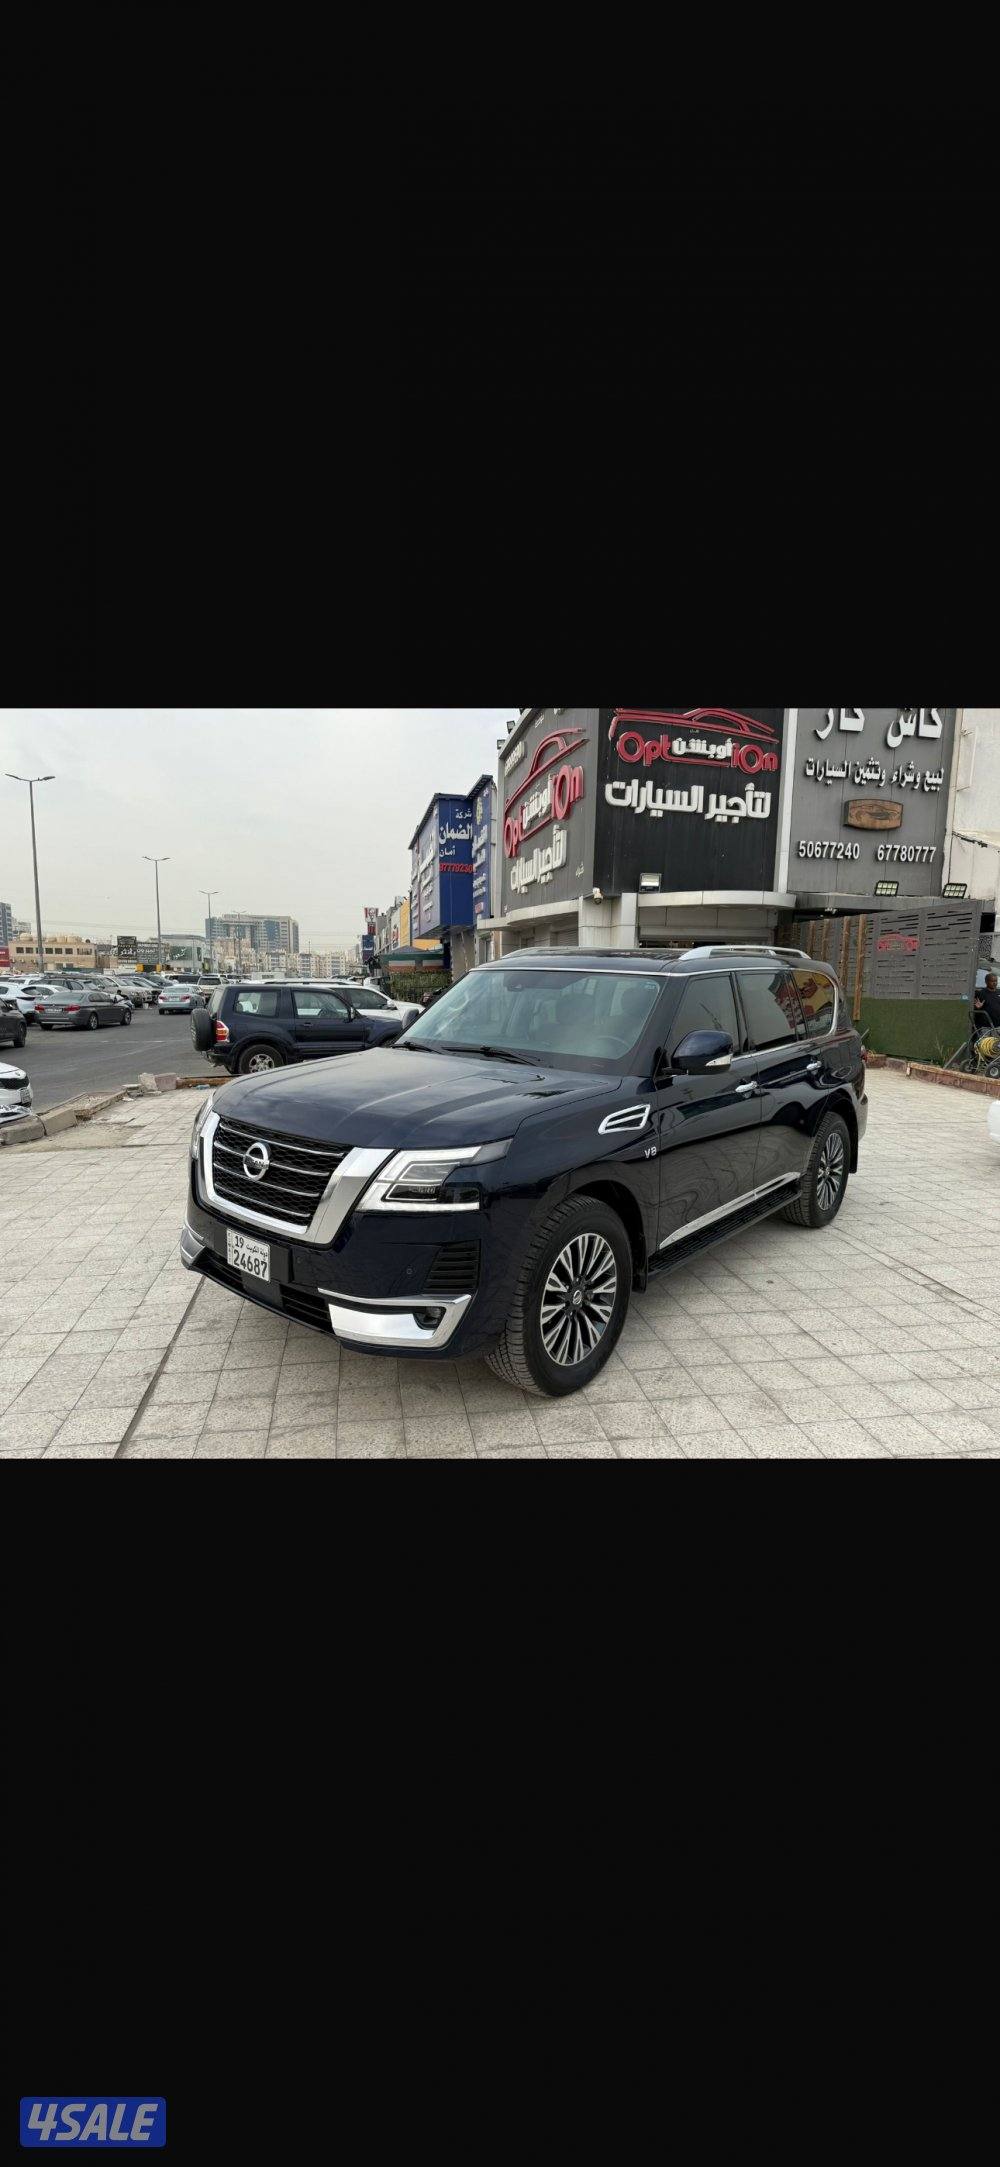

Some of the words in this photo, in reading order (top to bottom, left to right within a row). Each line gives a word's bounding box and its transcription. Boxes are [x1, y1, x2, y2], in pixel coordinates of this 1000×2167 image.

[805, 757, 851, 785] السيارات
[854, 757, 886, 787] وتثمين
[891, 761, 921, 789] وشراء
[924, 767, 945, 791] لبيع
[605, 778, 705, 818] السيارات
[704, 782, 772, 824] لتأجير
[455, 808, 472, 819] شركة
[439, 822, 473, 844] الضمان
[538, 824, 567, 884] لتأجير
[798, 840, 860, 860] 50677240
[877, 844, 937, 862] 67780777
[510, 848, 540, 894] السيارات
[644, 1146, 657, 1159] V8
[234, 1235, 245, 1248] 19
[233, 1249, 268, 1278] 24687
